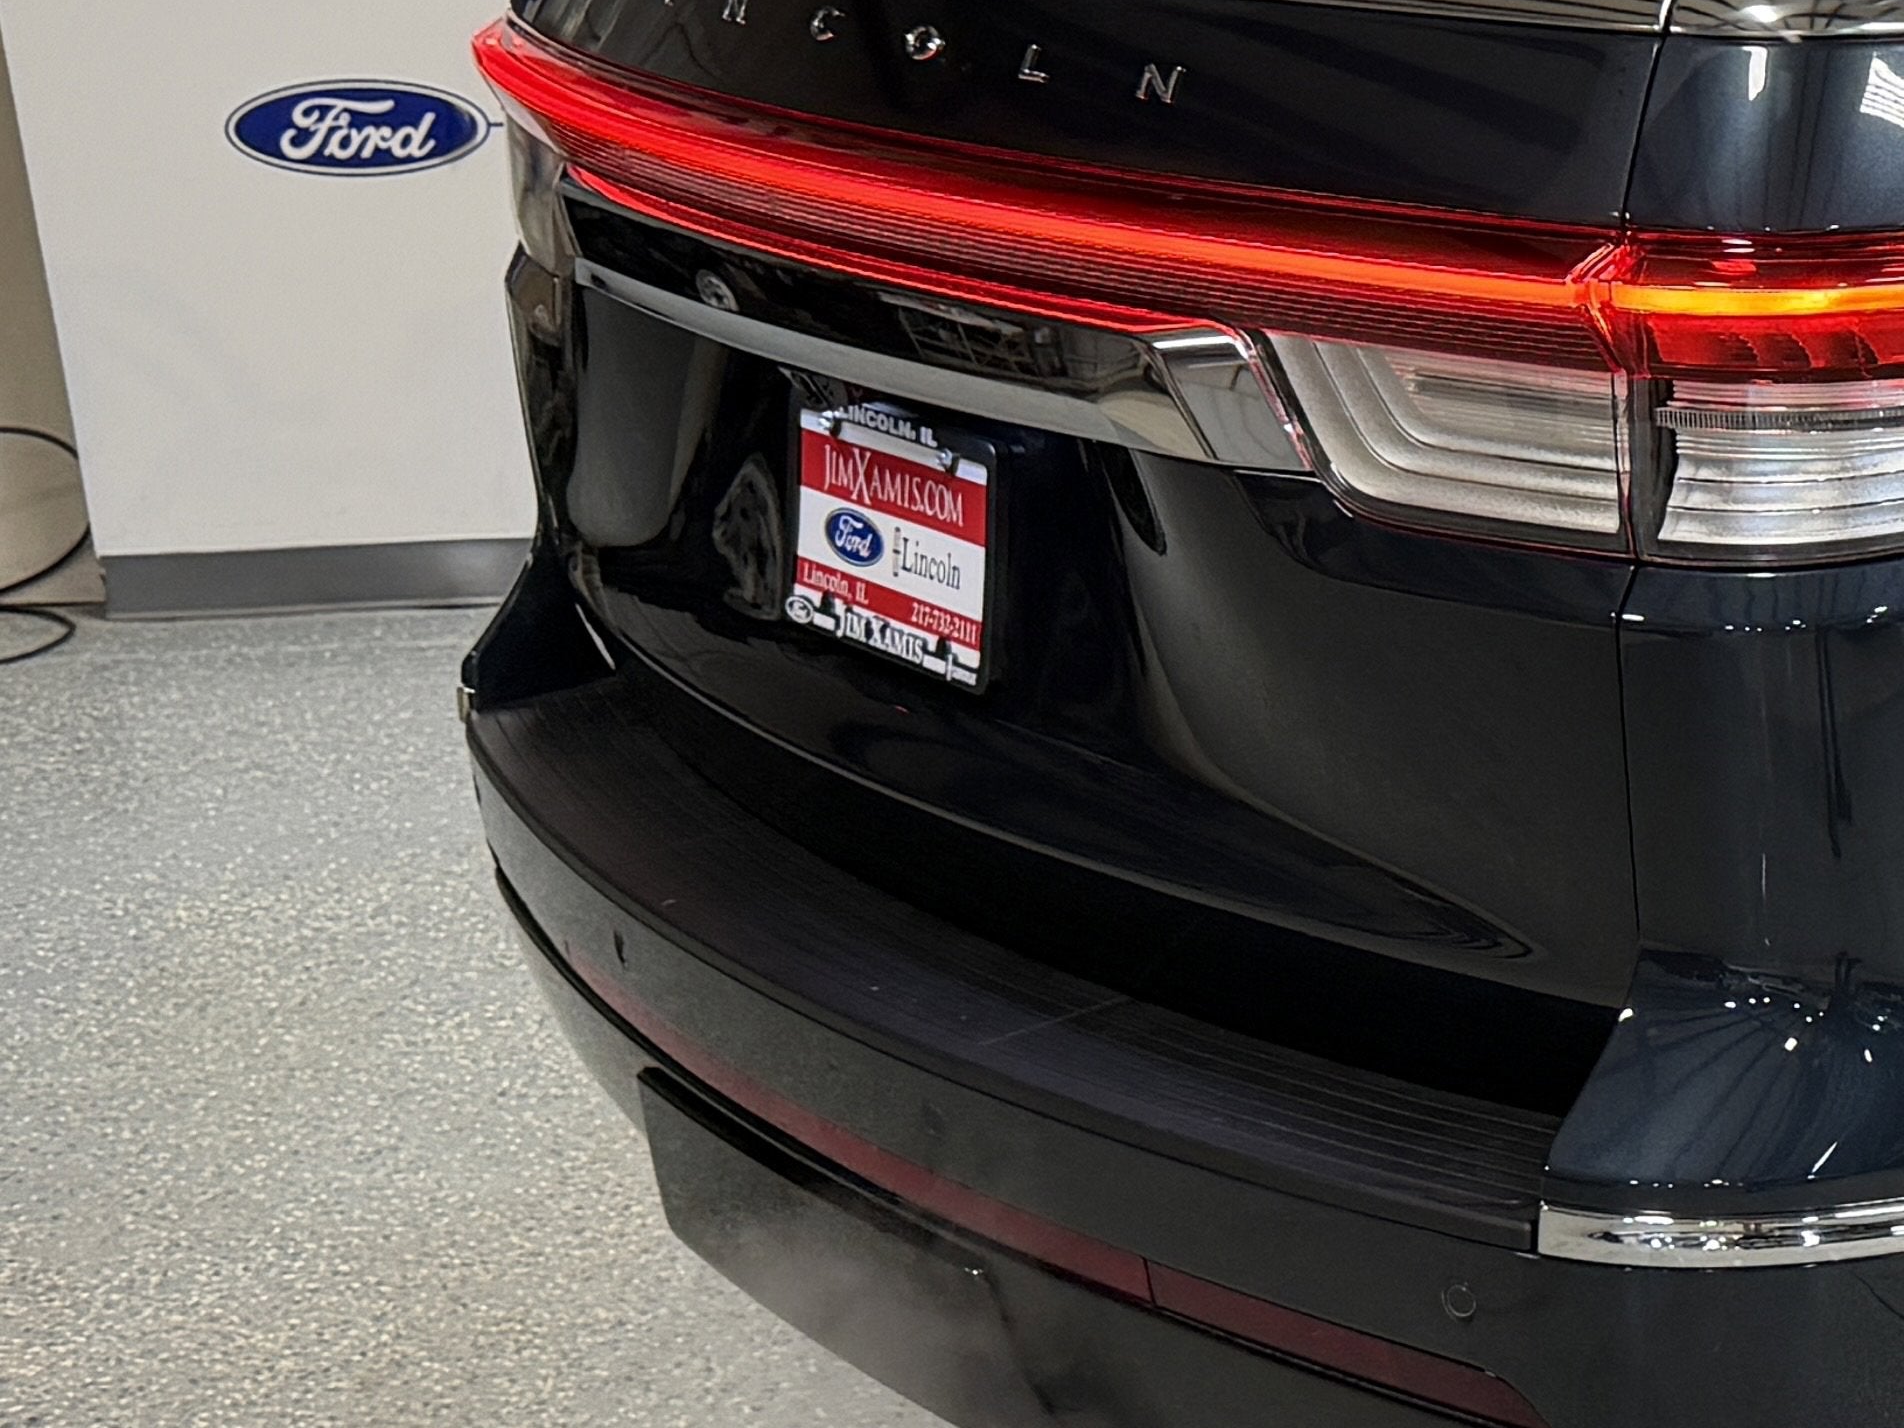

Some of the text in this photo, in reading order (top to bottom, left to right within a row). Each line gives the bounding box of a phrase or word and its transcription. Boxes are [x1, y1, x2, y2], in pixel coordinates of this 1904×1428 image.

[279, 97, 437, 160] Ford
[919, 425, 939, 448] IL
[823, 443, 964, 528] JIMXAMIS.COM
[803, 562, 869, 605] Lincoln, IL
[834, 515, 962, 591] Ford Lincoln
[835, 599, 867, 644] JIM
[868, 617, 924, 665] XAMIS
[910, 602, 977, 645] 217-732-2111
